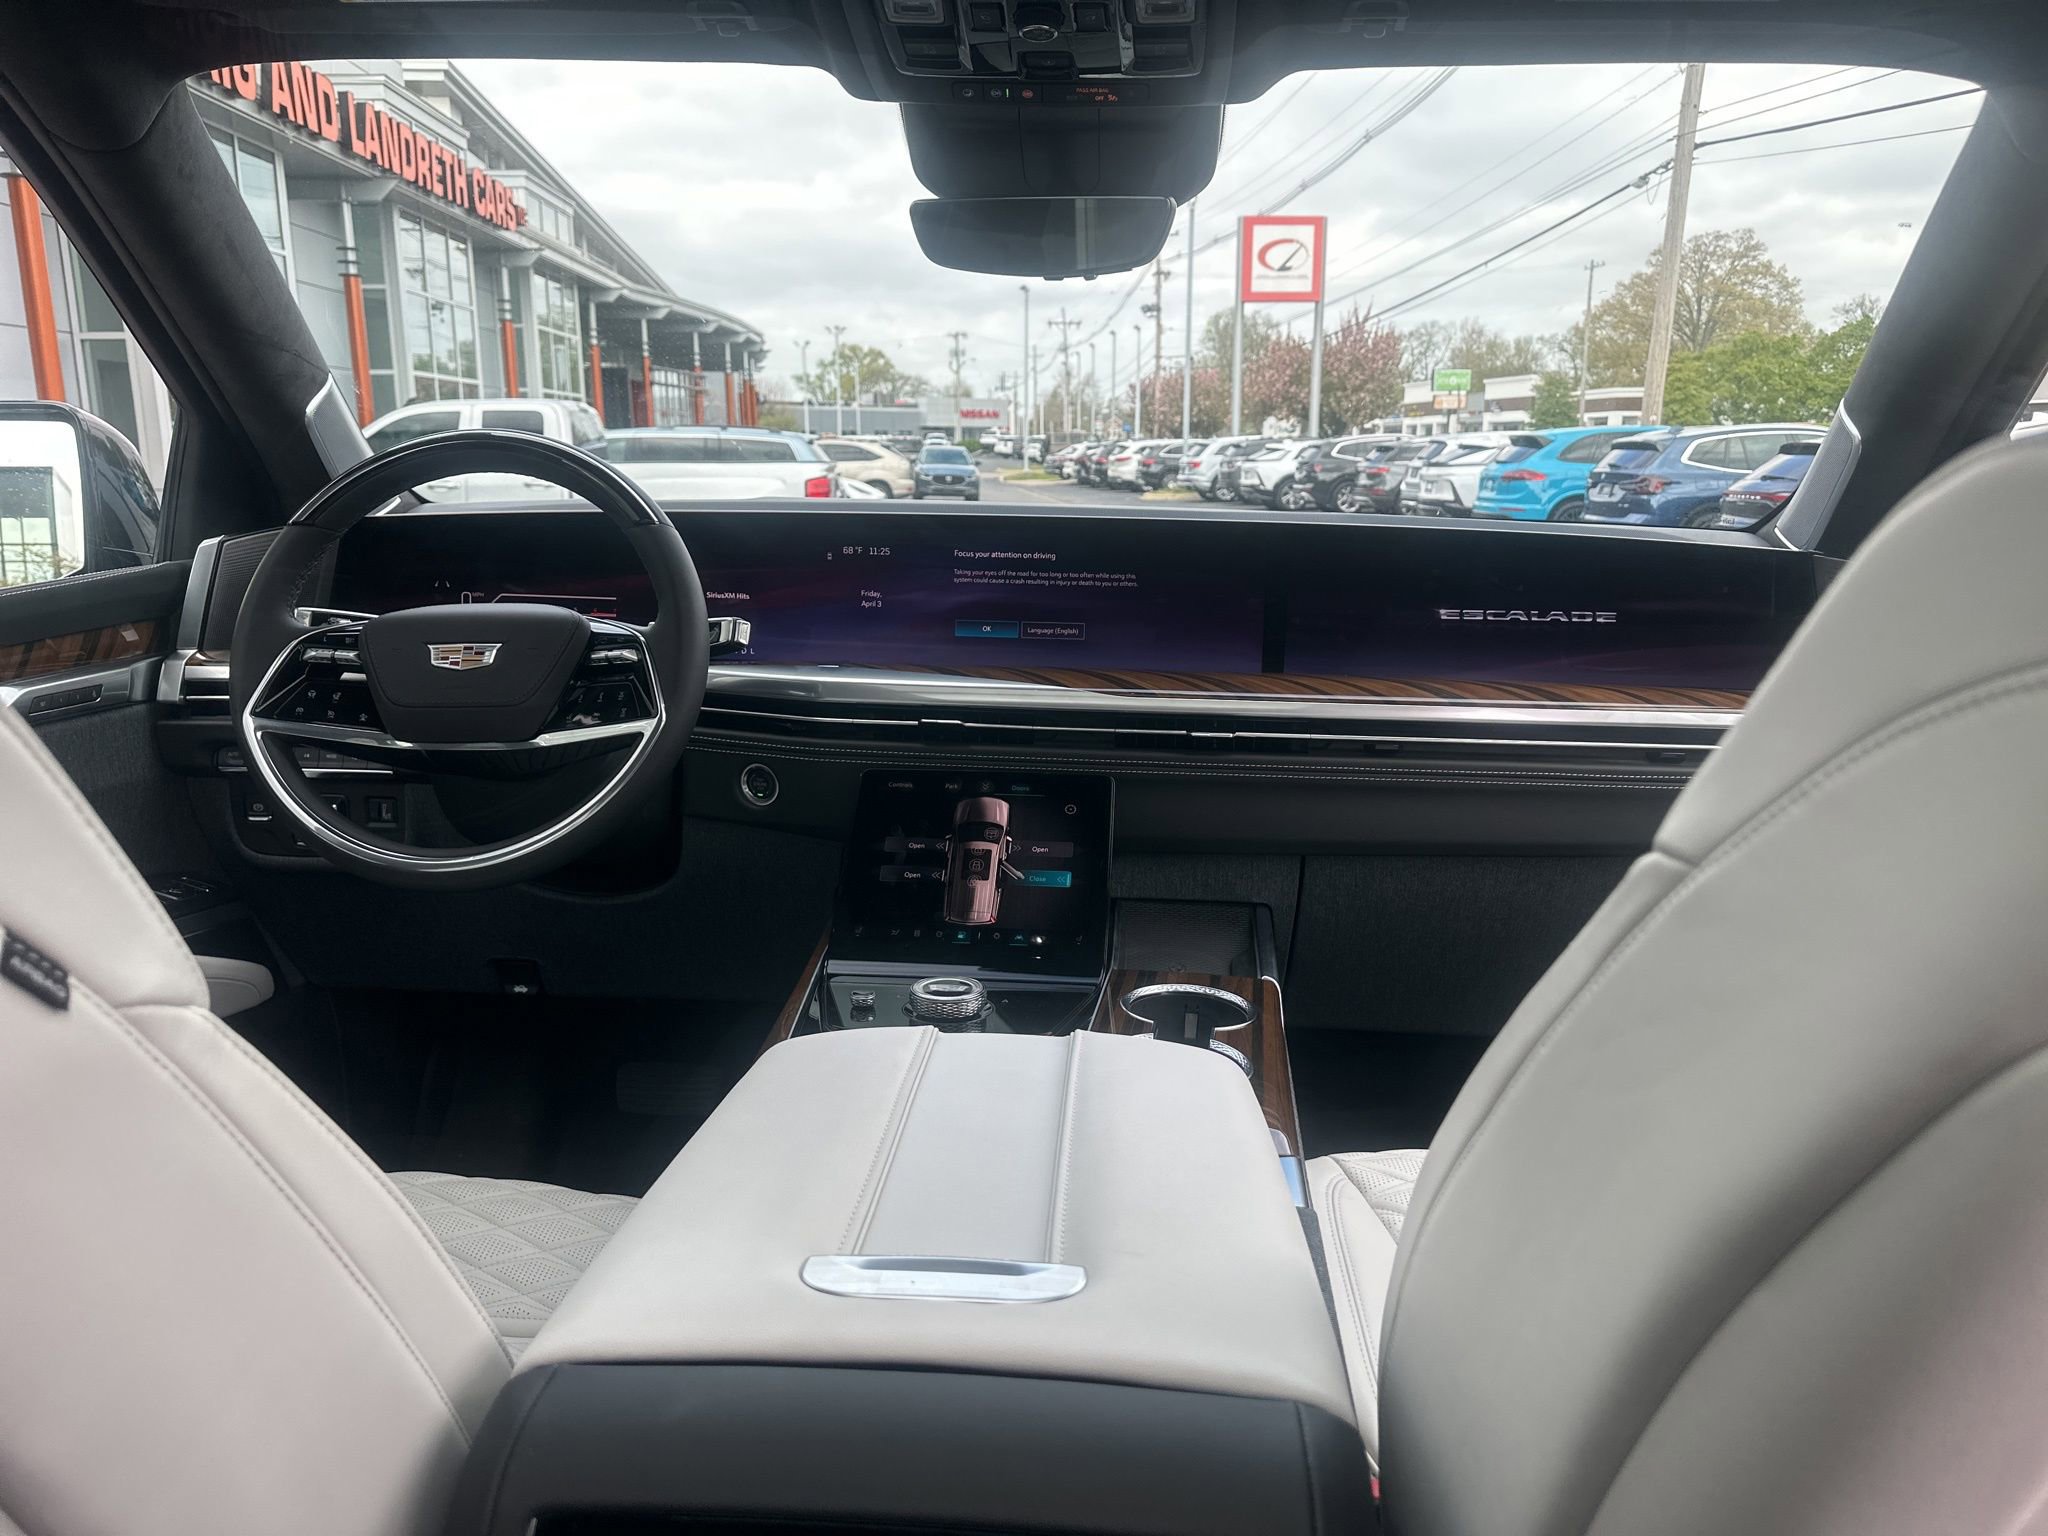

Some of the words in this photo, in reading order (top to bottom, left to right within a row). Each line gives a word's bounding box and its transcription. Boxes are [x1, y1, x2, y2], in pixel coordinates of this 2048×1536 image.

[271, 61, 339, 142] AND
[347, 90, 470, 209] LANDRETH
[472, 167, 517, 232] CARS
[960, 409, 1000, 420] NISSAN
[842, 546, 854, 555] 68
[869, 547, 891, 556] 11:25
[954, 549, 974, 557] Focus
[975, 551, 990, 559] your
[991, 551, 1022, 559] attention
[1033, 551, 1056, 561] driving
[953, 568, 972, 577] Taking
[998, 569, 1007, 577] off
[1049, 571, 1061, 579] long
[1079, 571, 1095, 579] often
[1110, 573, 1125, 581] using
[1025, 578, 1048, 587] resulting
[1056, 579, 1070, 587] injury
[1079, 579, 1095, 587] death
[706, 591, 736, 600] SiriusXM
[736, 592, 750, 600] Hits
[860, 589, 883, 599] Friday,
[860, 600, 876, 609] April
[876, 600, 882, 608] 3
[1439, 609, 1617, 623] ESCALADE
[1027, 627, 1054, 635] Language
[1054, 627, 1079, 635] (English)
[908, 842, 926, 850] Open
[1031, 846, 1049, 854] Open
[904, 871, 921, 879] Open
[1029, 875, 1047, 883] Close
